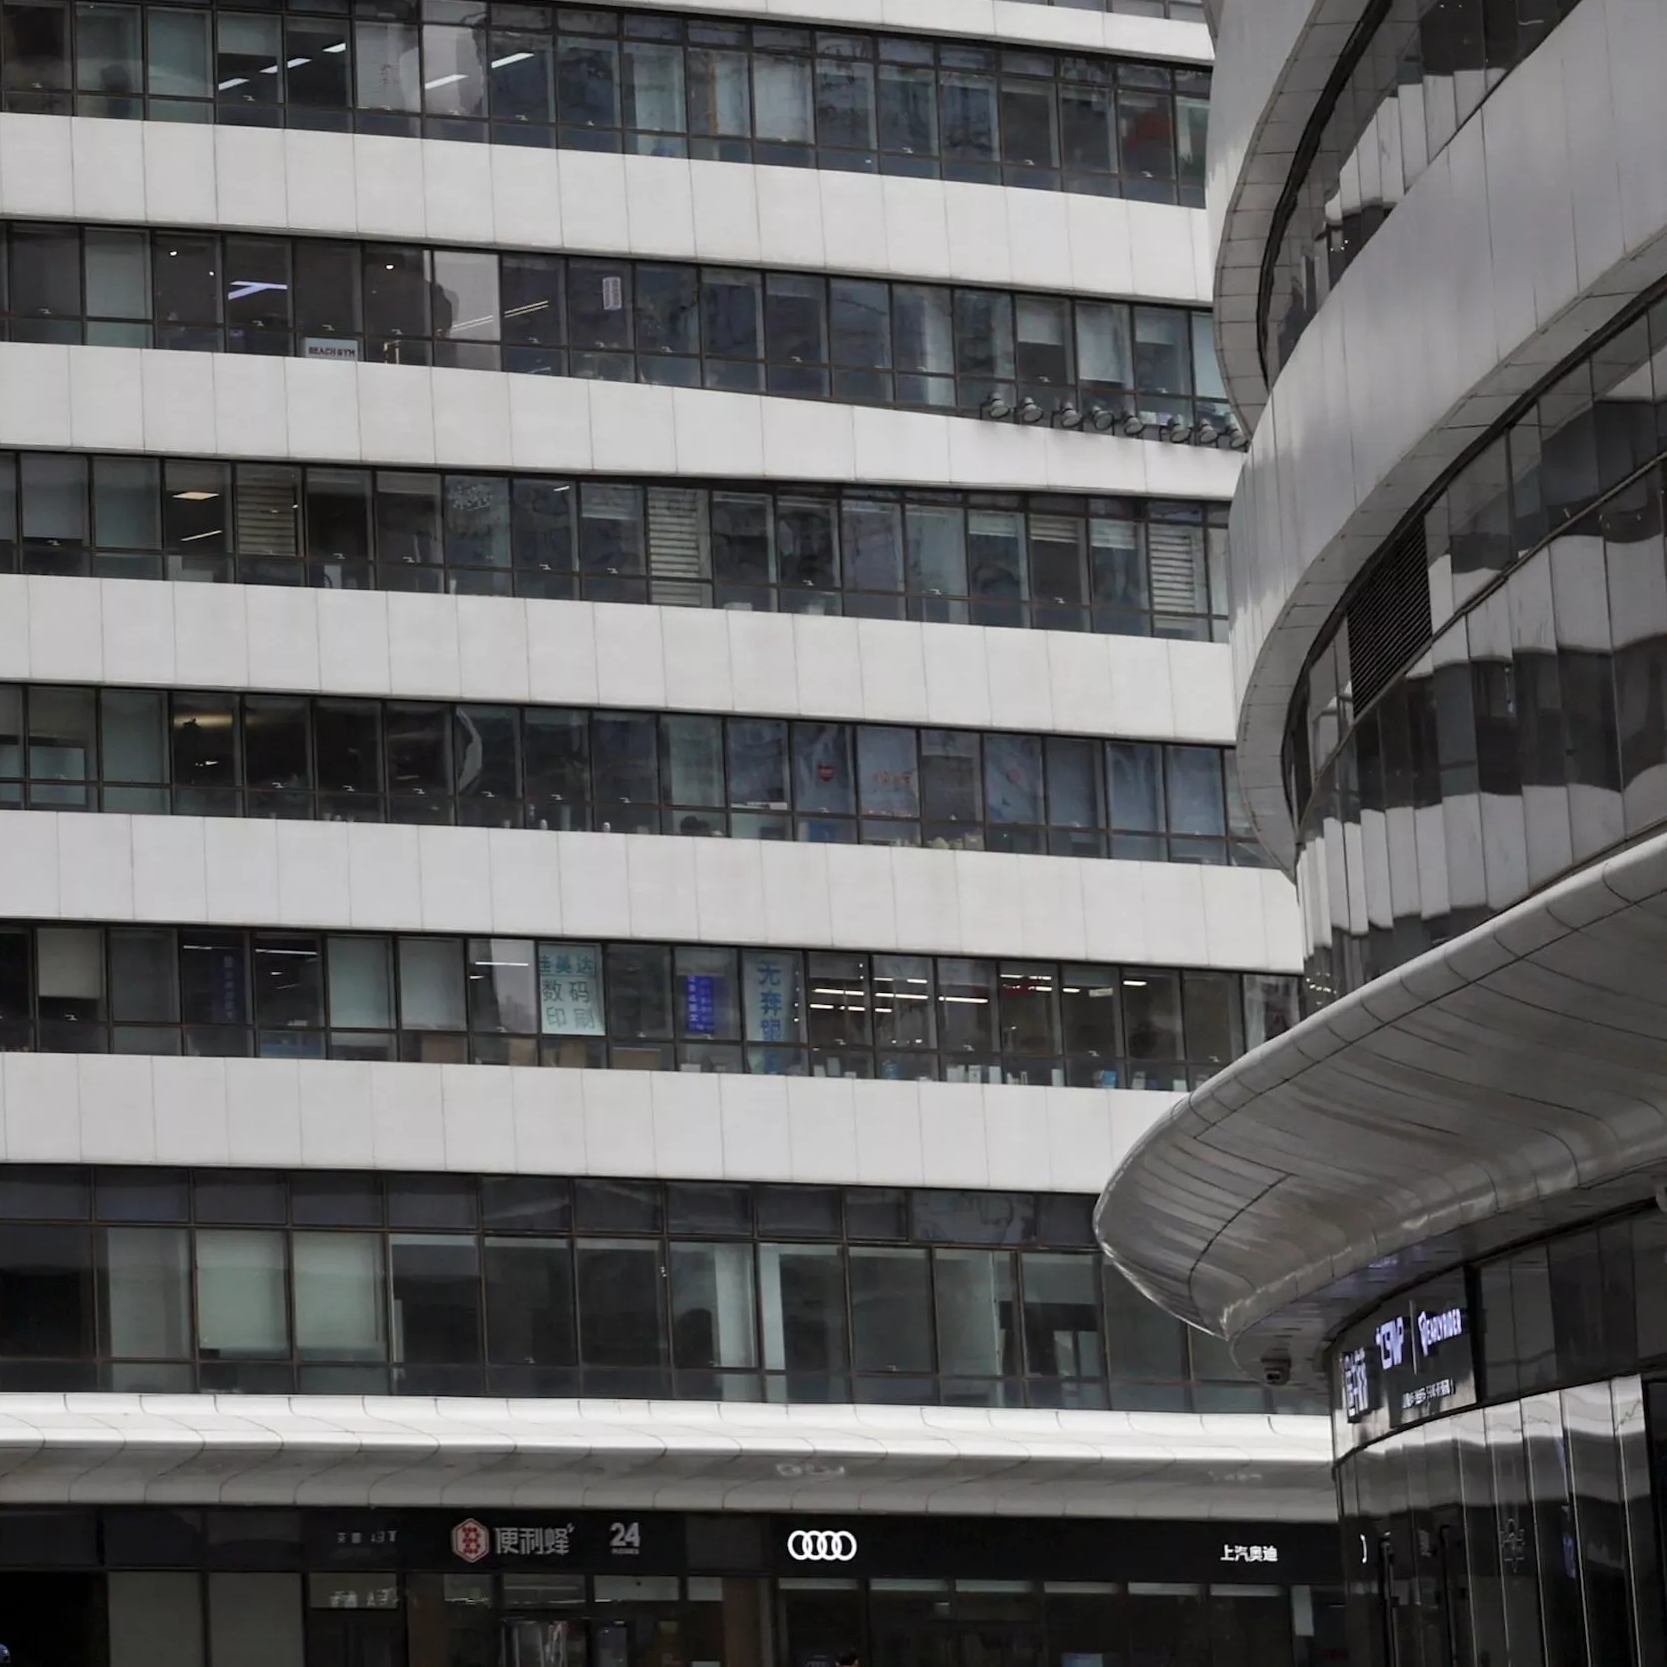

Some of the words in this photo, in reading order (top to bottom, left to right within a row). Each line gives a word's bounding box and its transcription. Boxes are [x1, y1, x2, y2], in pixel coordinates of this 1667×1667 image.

[542, 979, 590, 1003] 数码
[495, 1525, 571, 1555] 便利蜂
[610, 1522, 641, 1548] 24
[1220, 1544, 1279, 1562] 上汽奥迪
